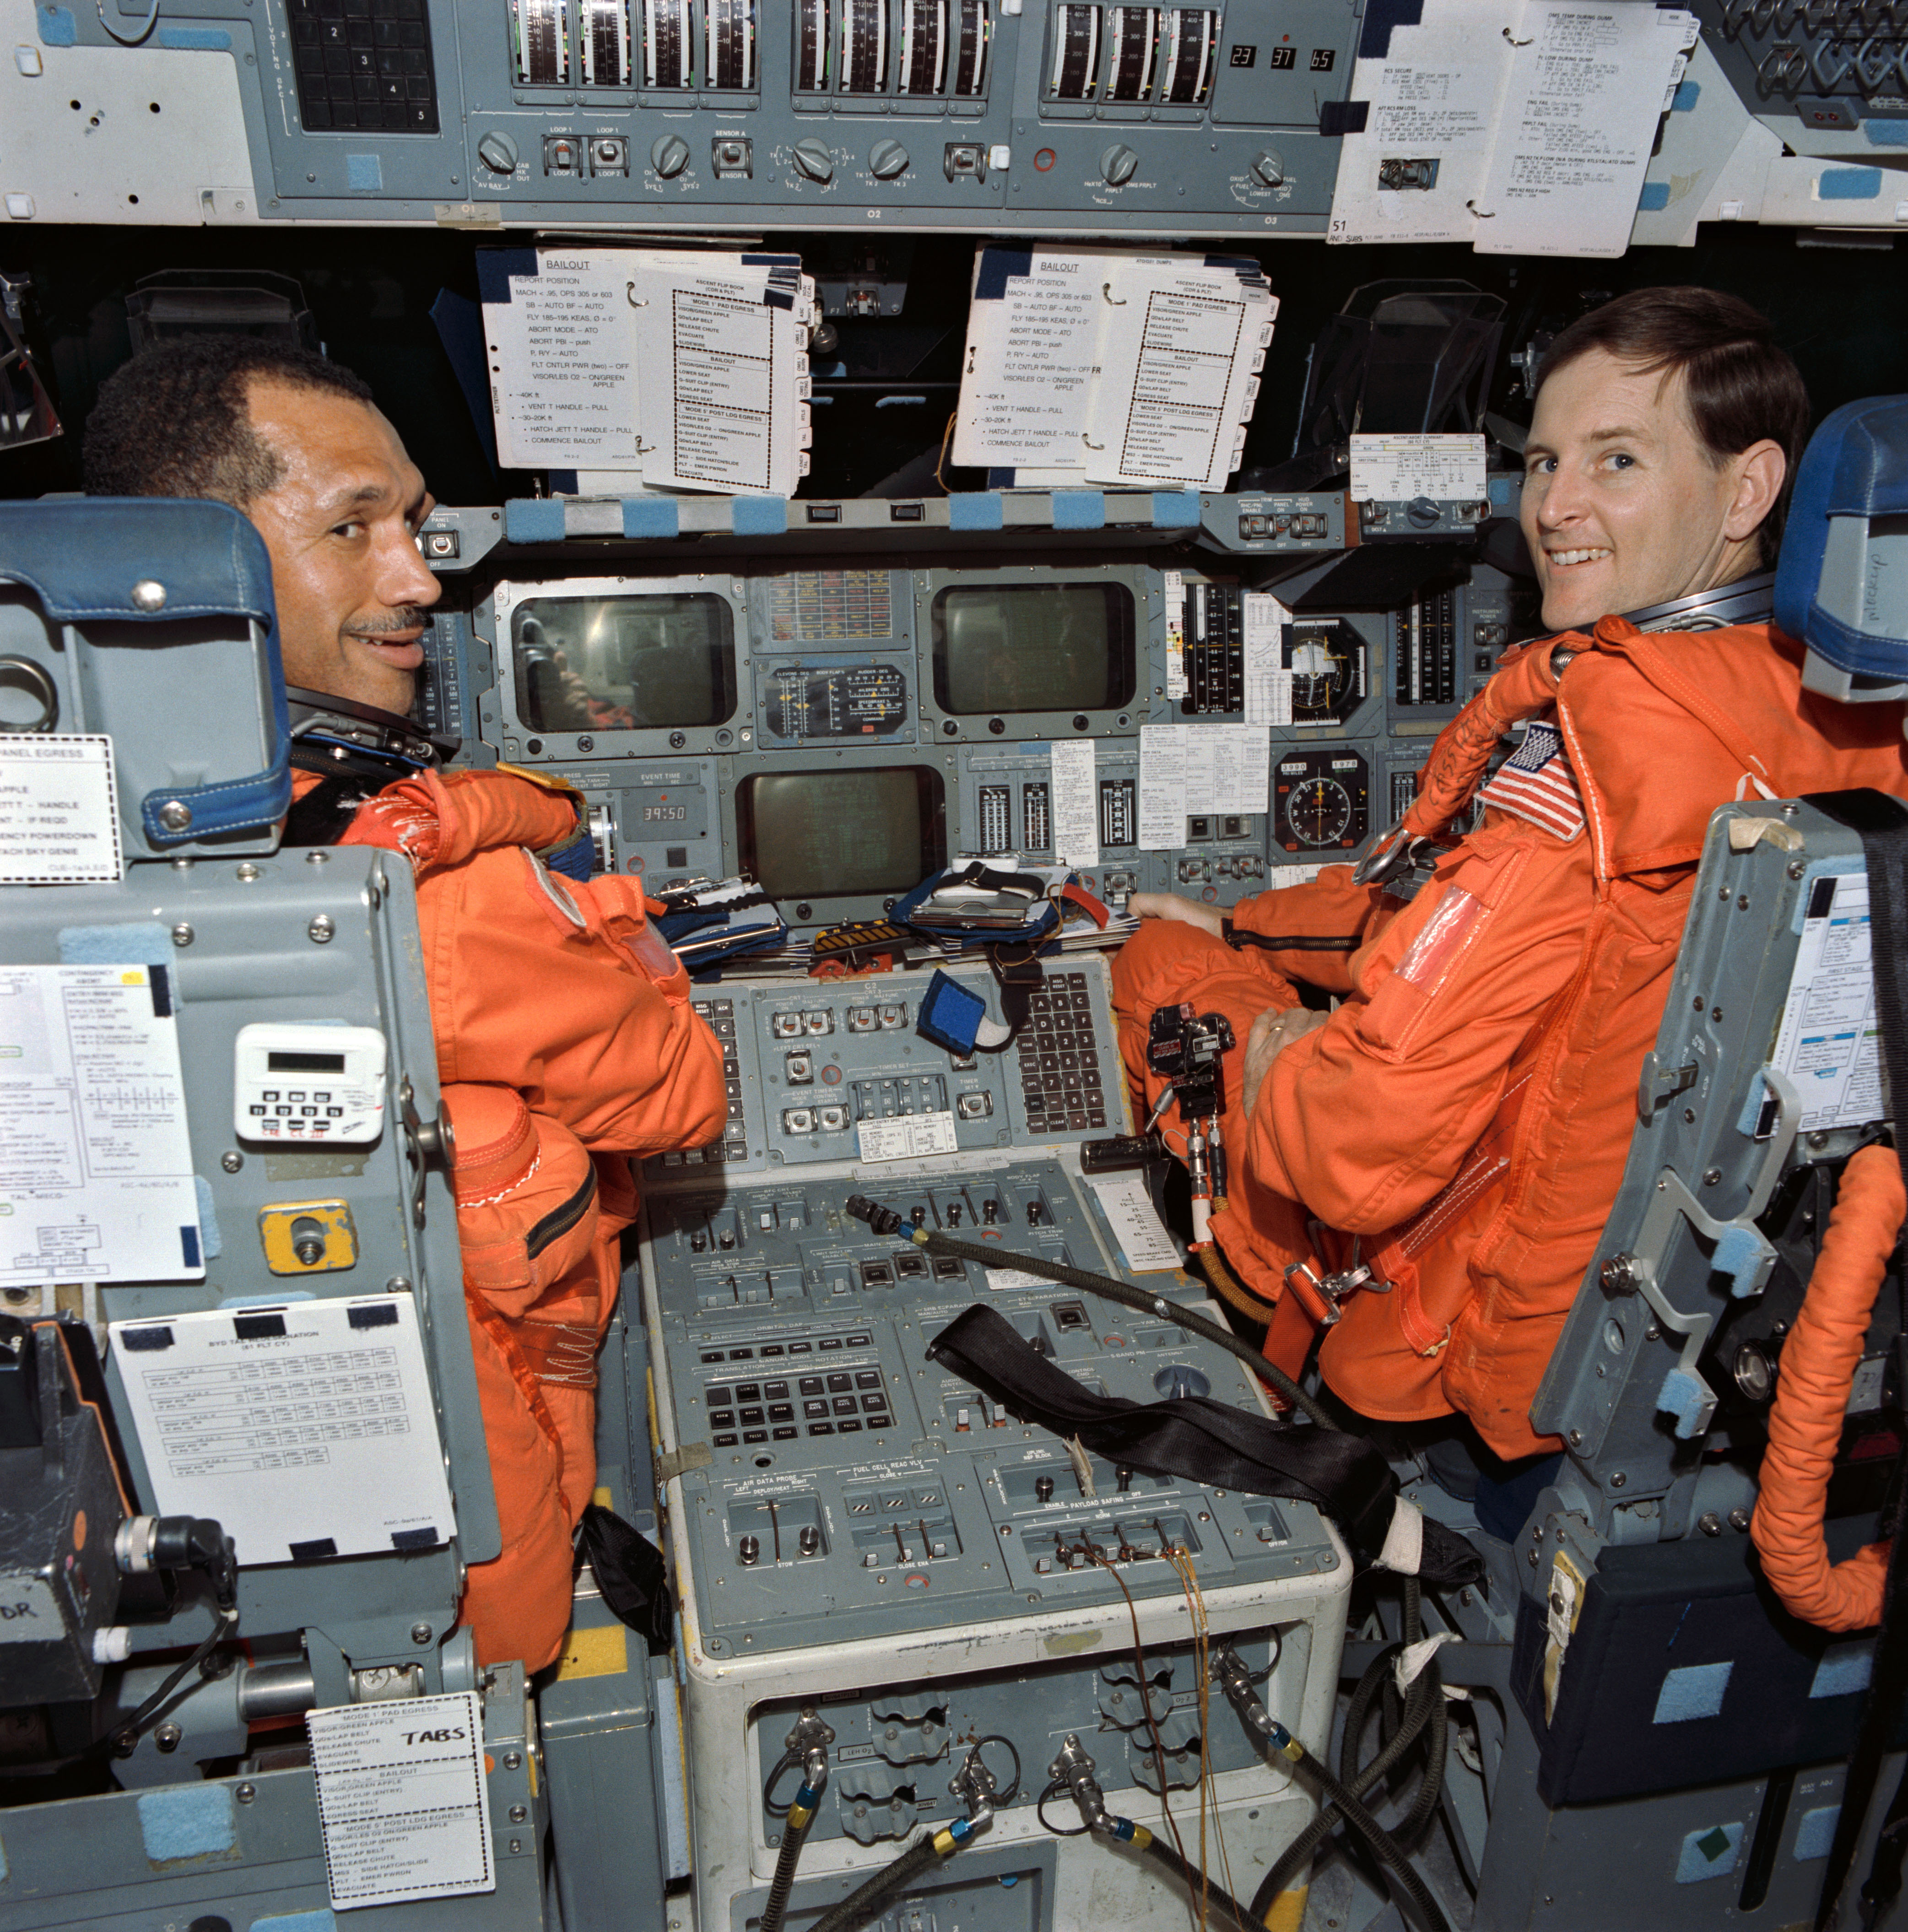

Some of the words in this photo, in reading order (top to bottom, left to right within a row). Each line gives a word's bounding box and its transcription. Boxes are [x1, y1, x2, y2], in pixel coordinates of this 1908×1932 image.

[331, 28, 337, 36] 2
[362, 56, 368, 65] 3
[1232, 48, 1251, 64] 23
[1272, 50, 1290, 65] 37
[1311, 52, 1329, 67] 65
[419, 111, 424, 119] 5
[1333, 221, 1346, 231] 51
[546, 260, 589, 270] BAILOUT
[1041, 262, 1079, 272] BAILOUT
[731, 304, 754, 313] EGRESS
[1204, 303, 1227, 312] EGRESS
[645, 807, 684, 820] 39:50
[816, 1354, 852, 1363] ROTATION
[715, 1364, 765, 1373] TRANSLATION
[1070, 1500, 1098, 1508] PAYLOAD
[1102, 1496, 1124, 1505] SAFING
[402, 1705, 438, 1714] EGRESS
[401, 1727, 465, 1746] TABS
[380, 1768, 417, 1777] BAILOUT
